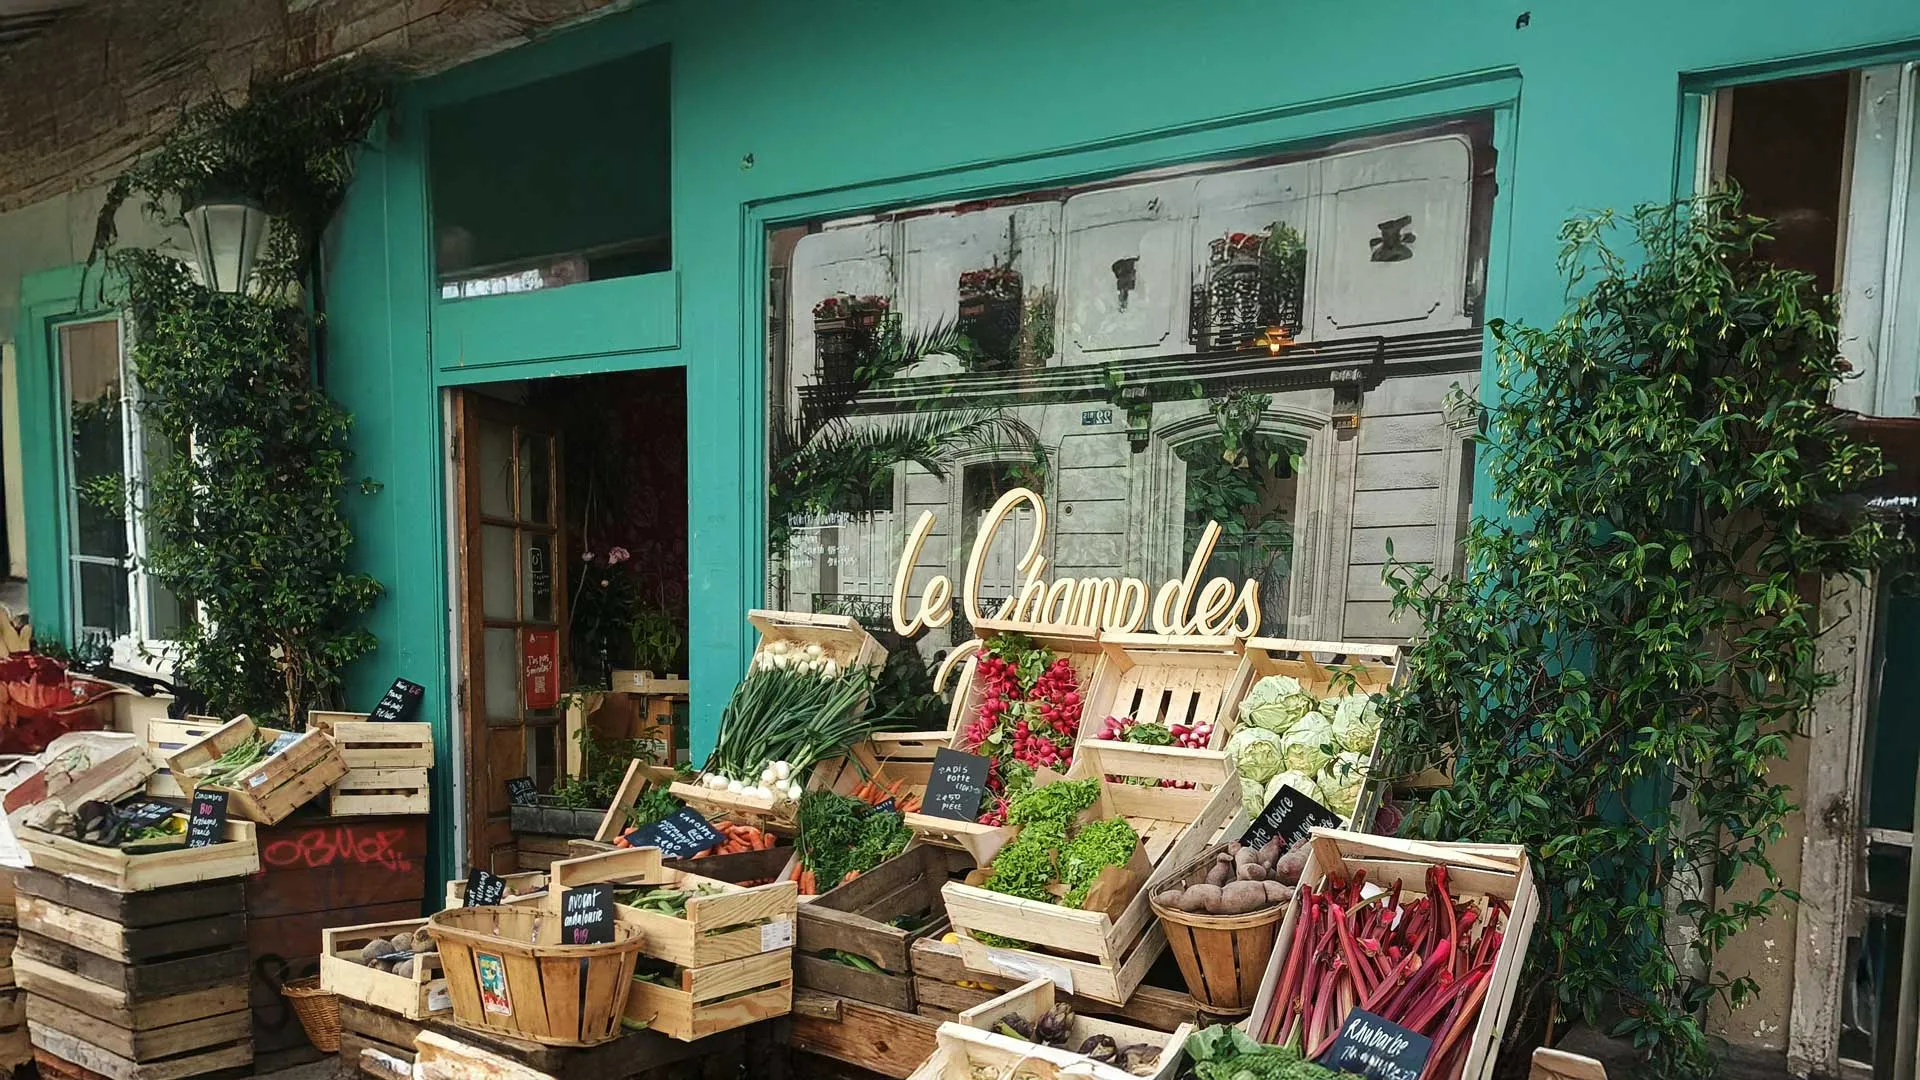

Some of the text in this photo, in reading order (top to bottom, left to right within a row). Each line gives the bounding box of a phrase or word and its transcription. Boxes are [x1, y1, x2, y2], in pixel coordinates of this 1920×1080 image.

[1153, 519, 1261, 639] des
[200, 802, 213, 815] BIO
[1264, 796, 1294, 829] douce
[1343, 1018, 1409, 1056] Rhubarbe
